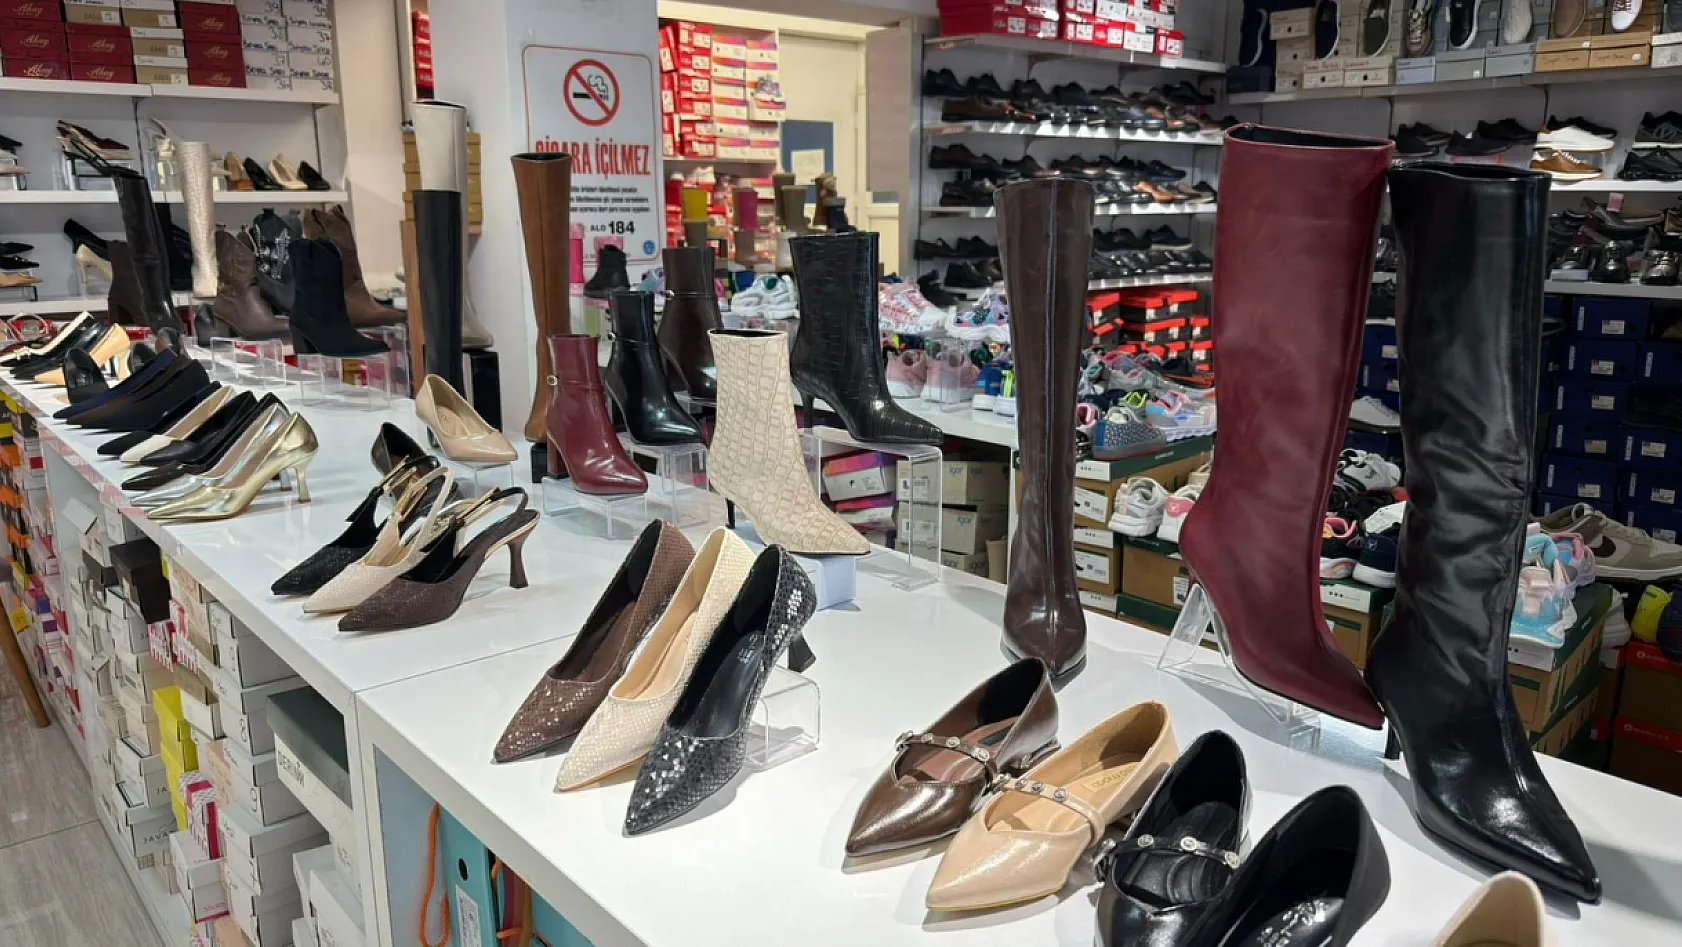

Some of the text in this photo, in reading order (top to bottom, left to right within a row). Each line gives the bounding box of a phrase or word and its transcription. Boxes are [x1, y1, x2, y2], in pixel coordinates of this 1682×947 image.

[595, 137, 651, 180] İÇİLMEZ
[590, 220, 636, 235] ALO 184
